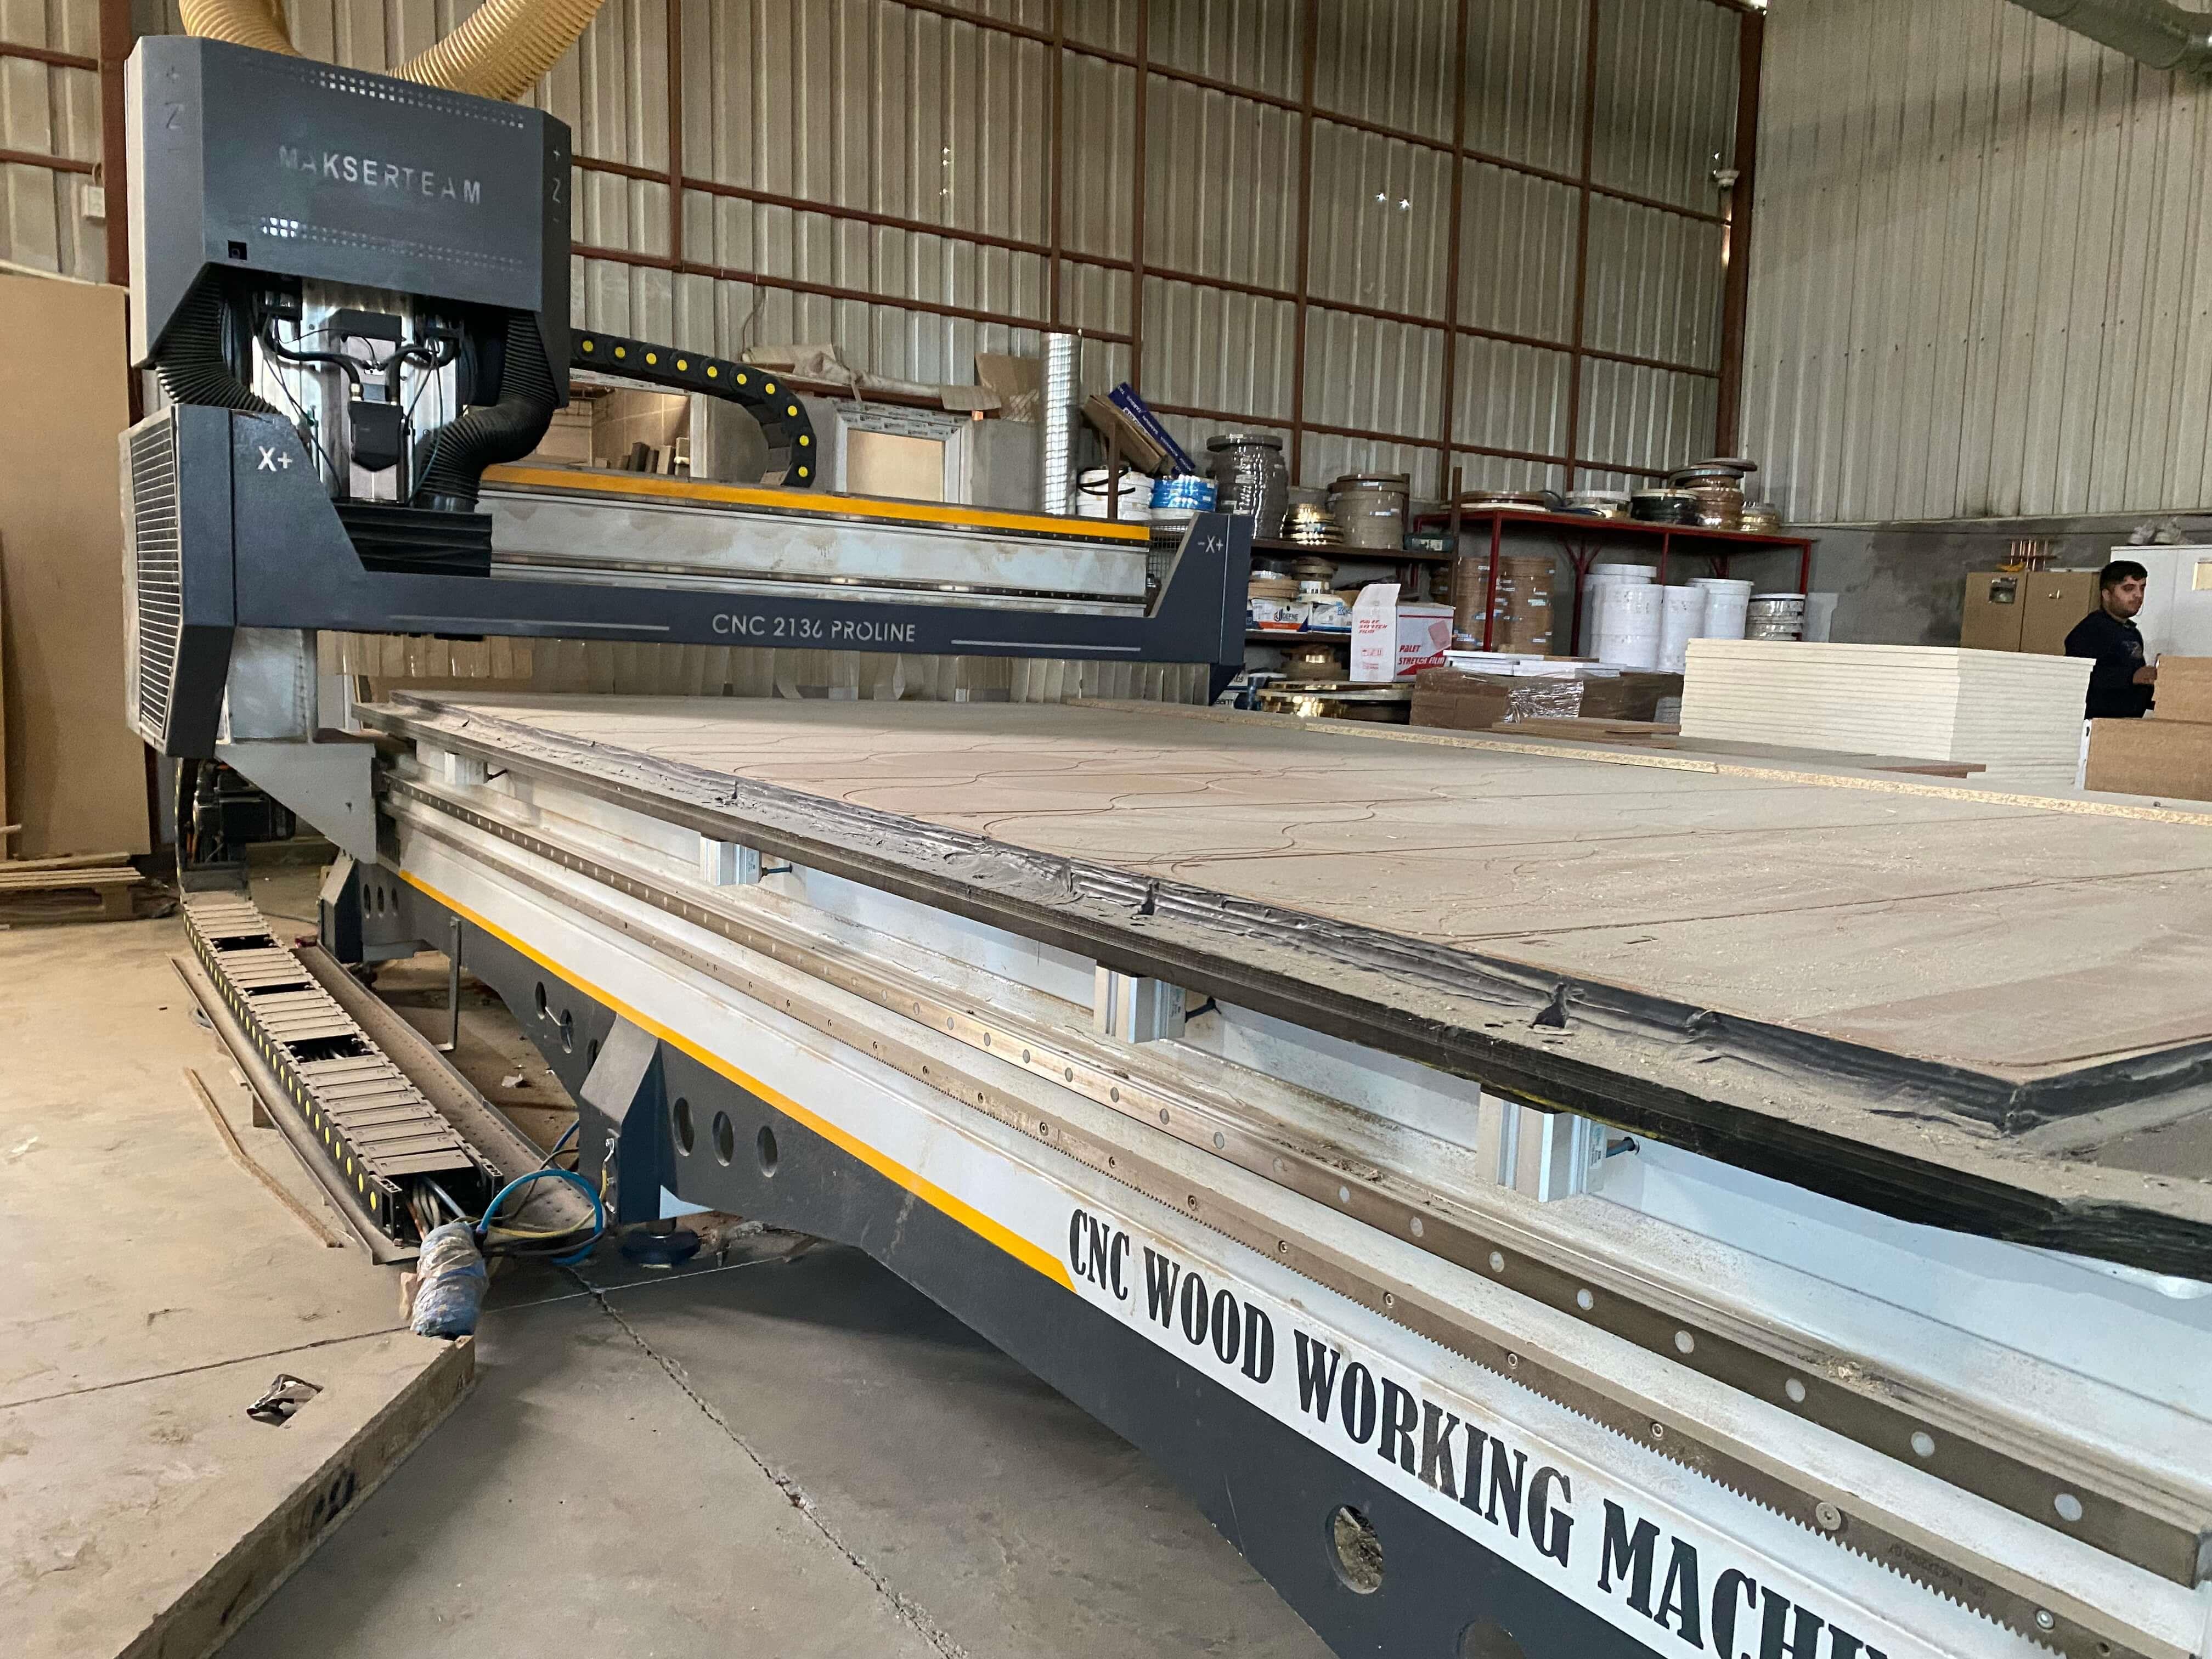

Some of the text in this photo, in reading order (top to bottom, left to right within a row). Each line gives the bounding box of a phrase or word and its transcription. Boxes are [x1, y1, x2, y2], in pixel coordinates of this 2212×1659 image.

[279, 146, 481, 204] MAKSERTEAM
[257, 446, 293, 472] X+
[712, 614, 916, 643] CNC 2136 PROLINE
[1070, 1209, 1887, 1659] CNC WOOD WORKING MACH
